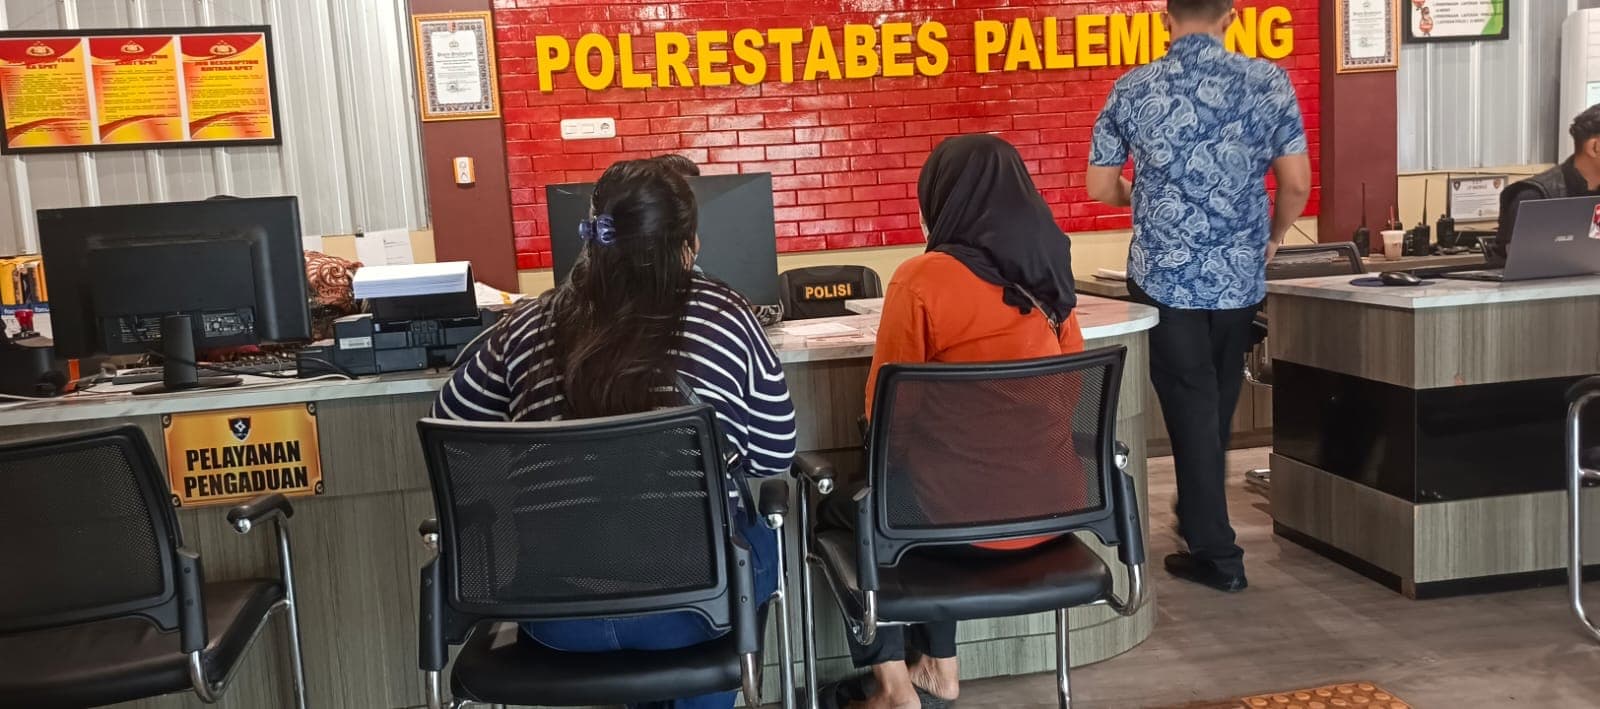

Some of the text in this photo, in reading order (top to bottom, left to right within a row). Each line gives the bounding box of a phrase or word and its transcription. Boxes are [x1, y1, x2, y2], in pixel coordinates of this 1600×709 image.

[535, 20, 949, 92] POLRESTABES
[974, 6, 1294, 74] PALEMNG
[805, 283, 852, 299] POLISI
[185, 440, 301, 471] PELAYANAN
[184, 466, 309, 498] PENGADUAN
